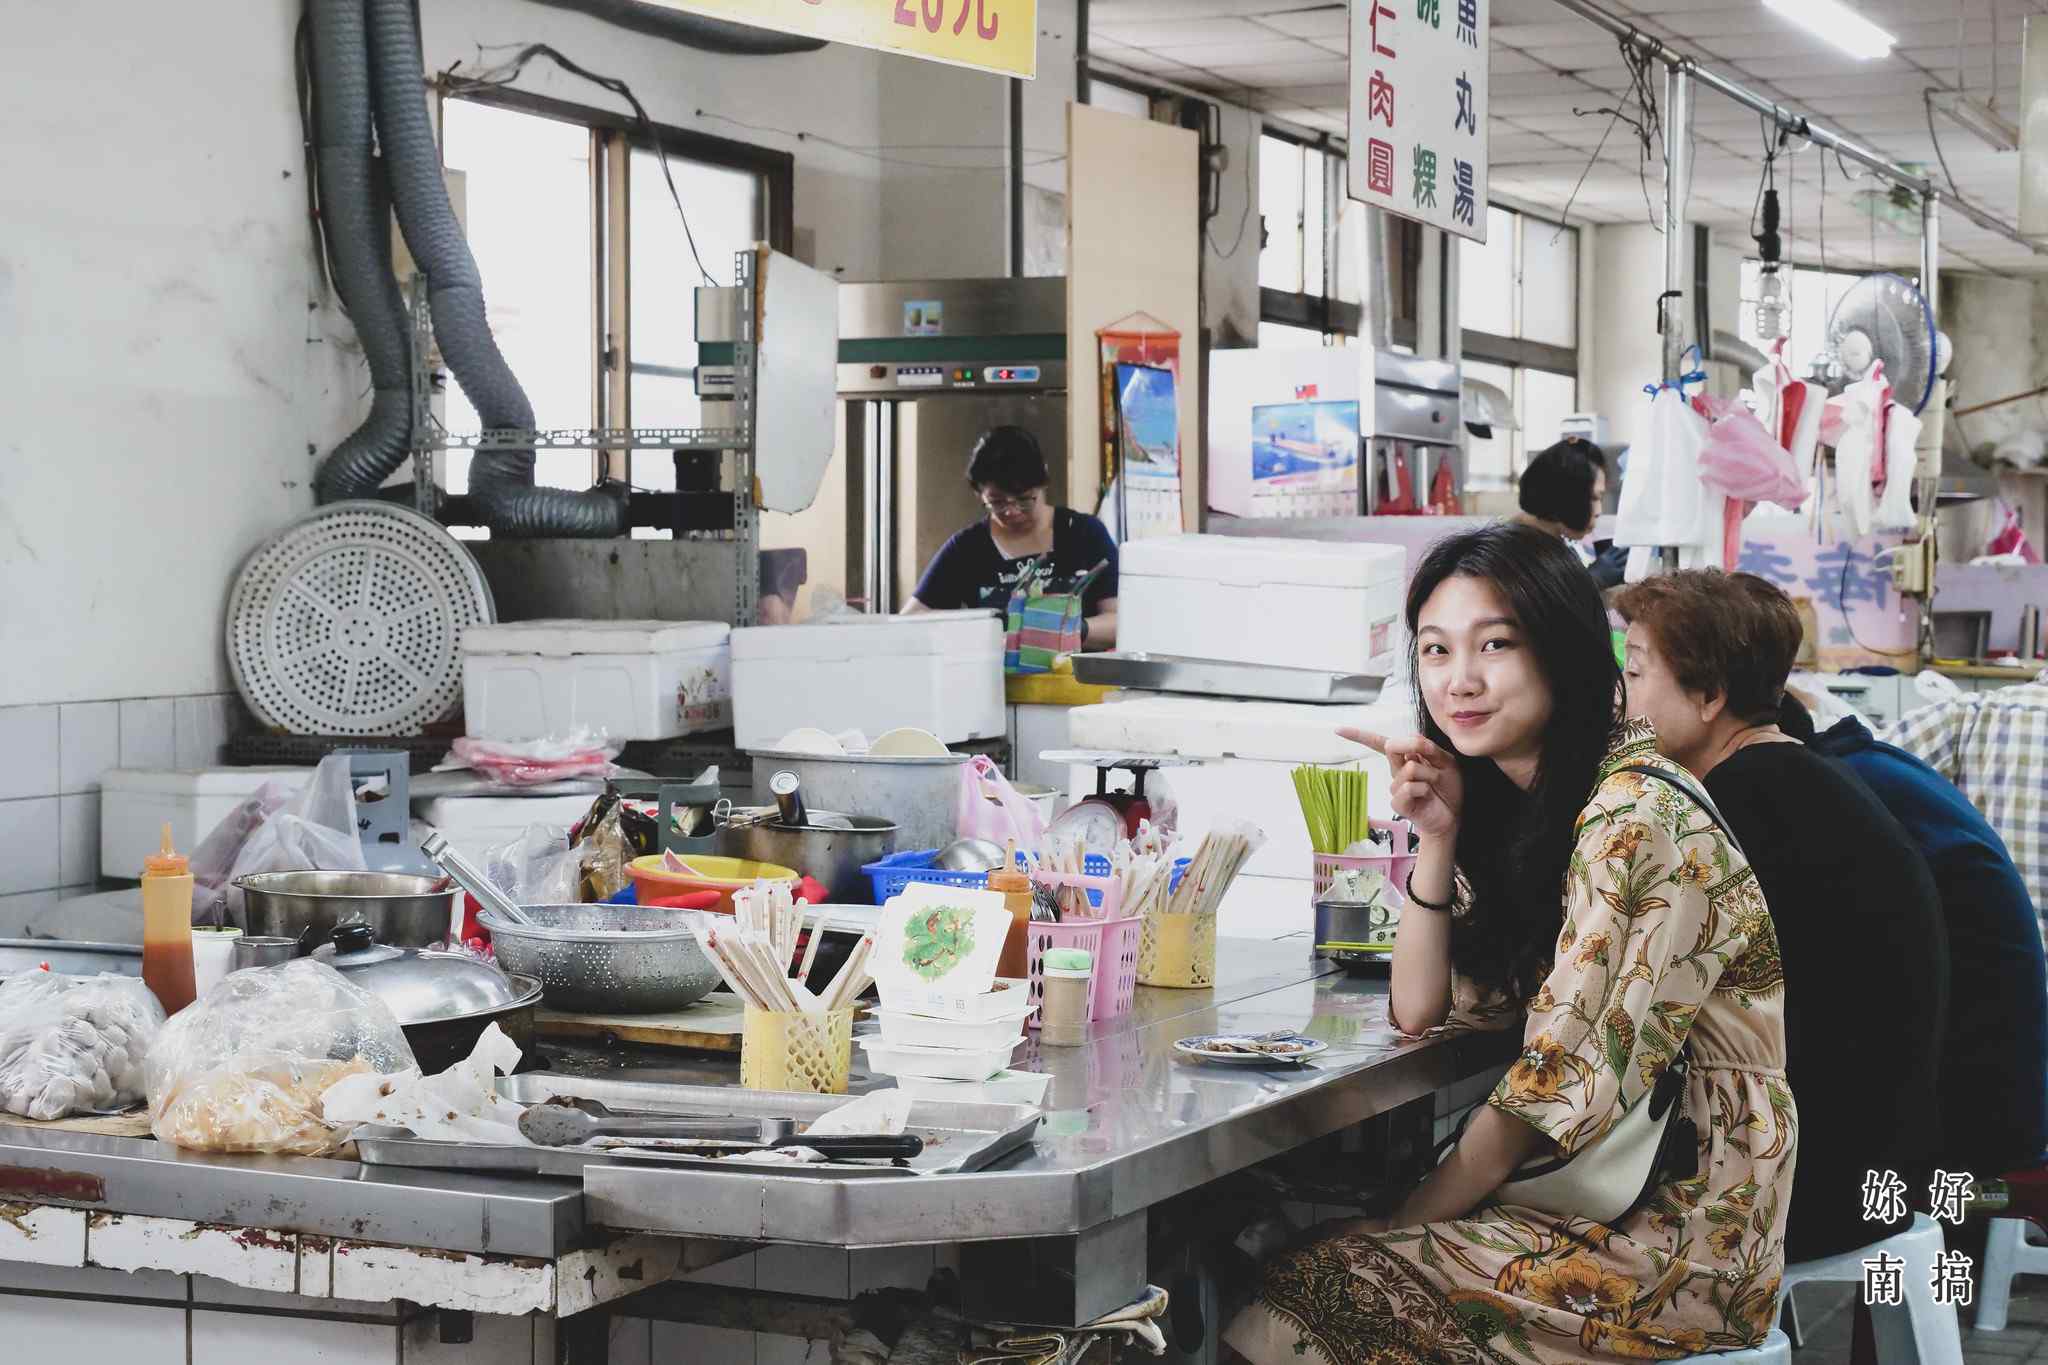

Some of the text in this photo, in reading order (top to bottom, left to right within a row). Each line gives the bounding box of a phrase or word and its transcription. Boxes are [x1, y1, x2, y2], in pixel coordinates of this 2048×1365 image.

[1368, 0, 1397, 197] 仁肉圓
[1452, 0, 1478, 227] 魚丸湯
